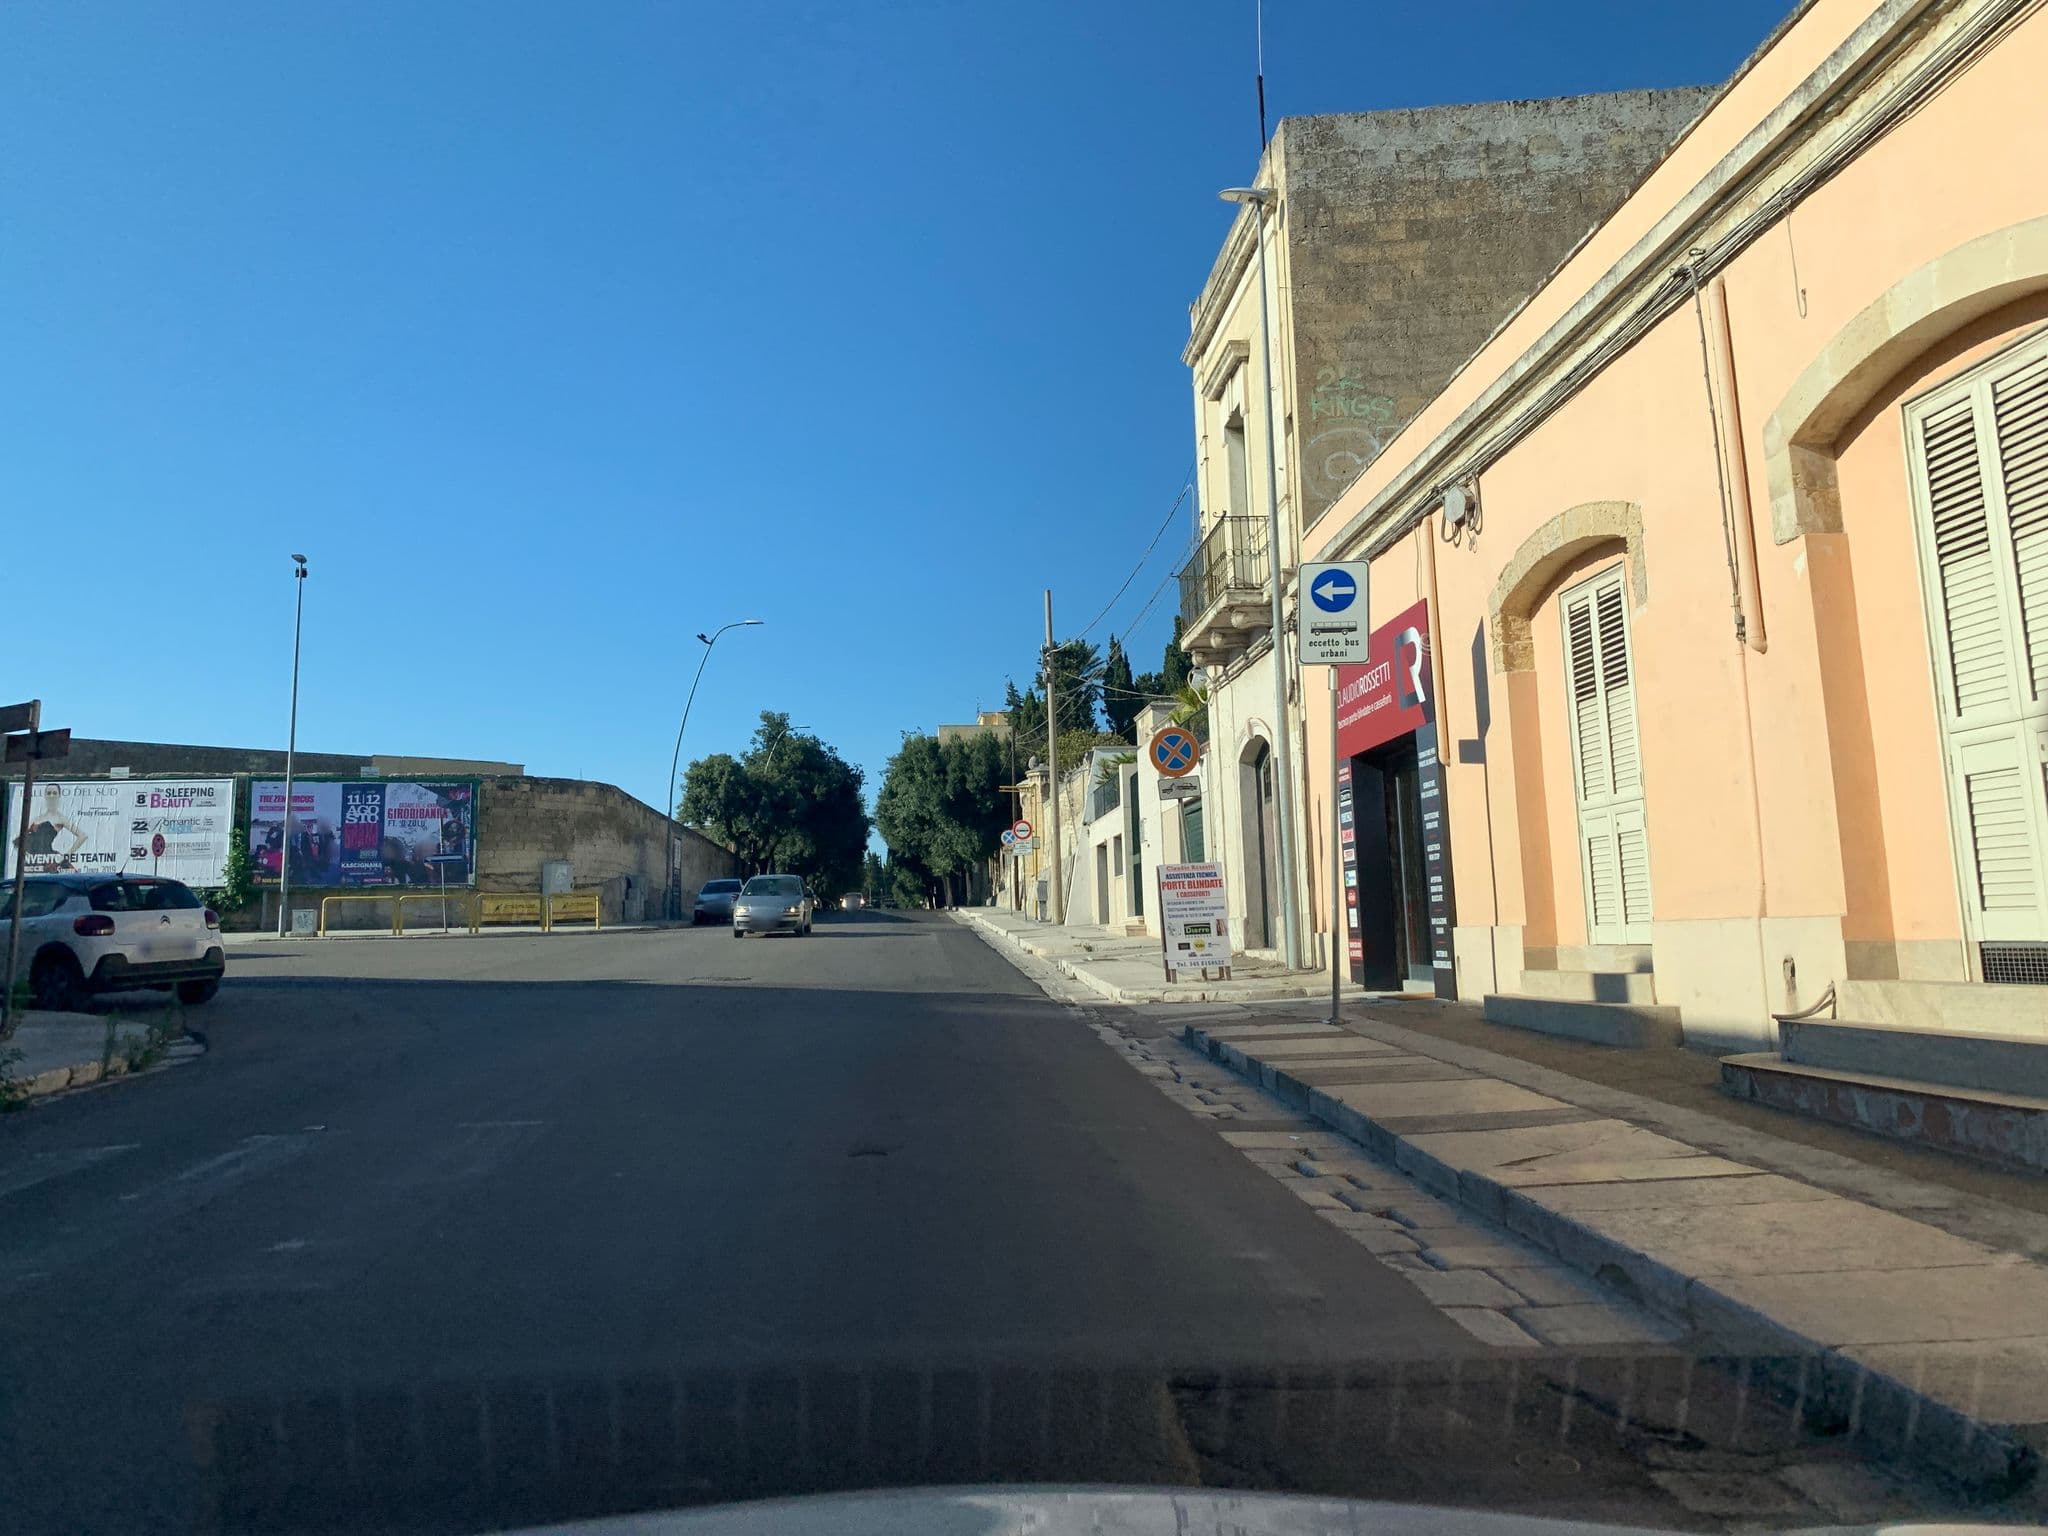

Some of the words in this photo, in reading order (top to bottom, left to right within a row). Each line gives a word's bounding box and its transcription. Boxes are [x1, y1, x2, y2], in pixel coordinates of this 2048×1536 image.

[1309, 638, 1340, 648] eccetto
[1345, 637, 1360, 647] bus
[1321, 648, 1347, 658] urbani
[97, 787, 118, 798] SUD
[165, 787, 214, 798] SLEEPING
[136, 795, 146, 804] 8
[347, 794, 361, 805] 11
[366, 794, 380, 805] 12
[132, 821, 148, 831] 22
[130, 847, 147, 857] 30
[25, 852, 64, 865] NVENTO
[64, 853, 79, 863] DEI
[81, 852, 116, 863] TEATINI
[1162, 881, 1186, 891] PORTE
[1188, 879, 1223, 890] BLINDATE
